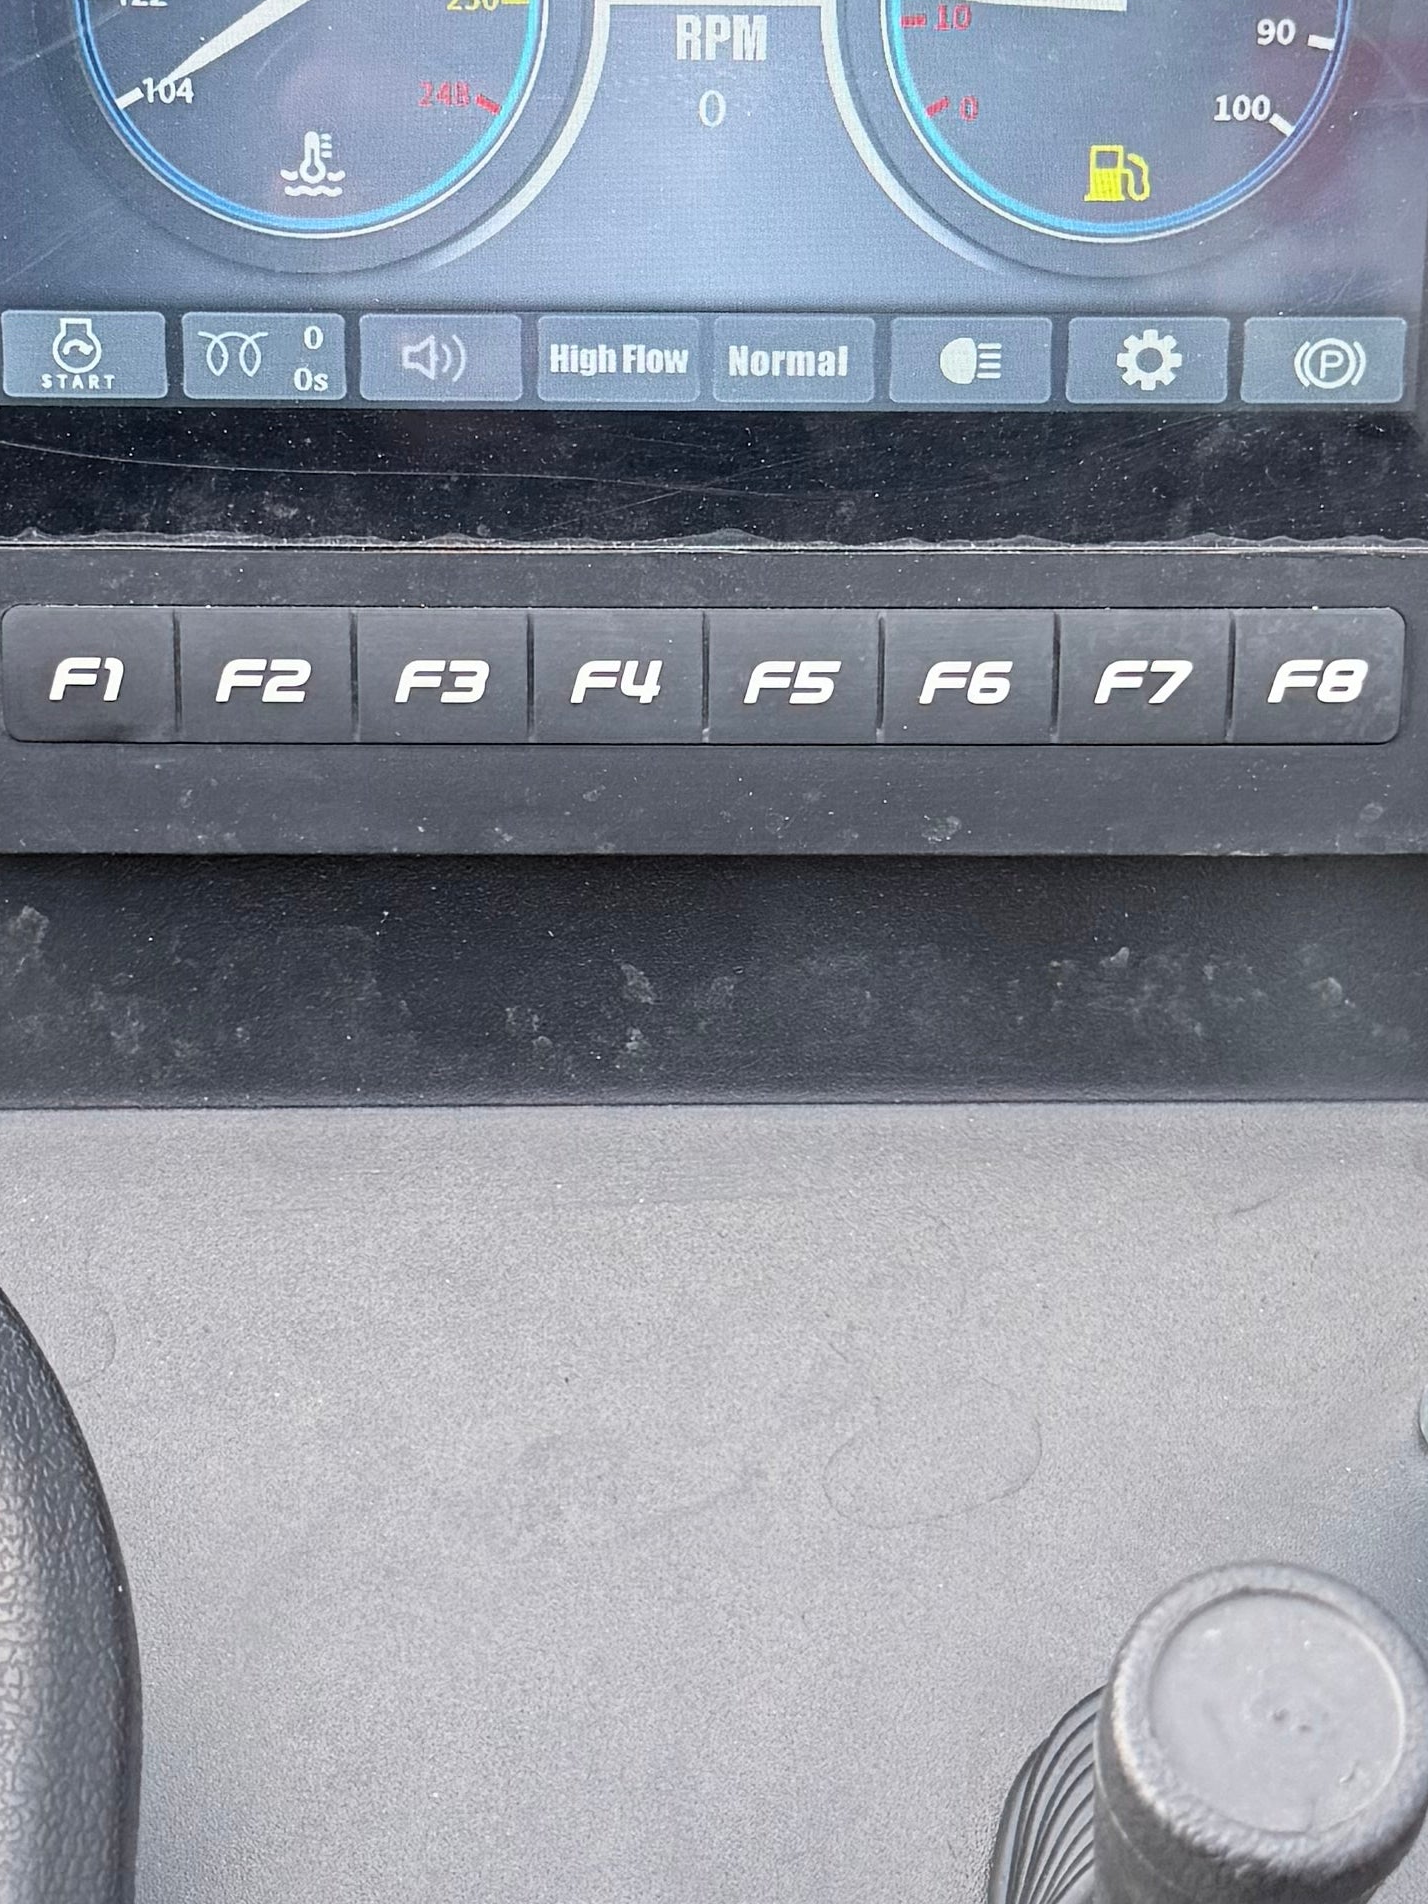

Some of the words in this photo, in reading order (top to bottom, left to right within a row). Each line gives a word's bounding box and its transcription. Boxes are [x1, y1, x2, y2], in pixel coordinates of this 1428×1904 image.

[934, 4, 972, 32] 10
[1256, 18, 1295, 46] 90
[676, 14, 767, 61] RPM
[142, 77, 194, 105] 104
[699, 89, 726, 127] 0
[959, 96, 979, 122] 0
[1213, 94, 1271, 123] 100
[303, 325, 324, 350] 0
[550, 343, 616, 377] High
[622, 344, 689, 375] Flow
[728, 345, 849, 378] Normal
[41, 373, 115, 390] START
[48, 656, 126, 703] F1
[215, 657, 315, 704] F2
[394, 658, 491, 704] F3
[570, 659, 664, 704] F4
[742, 660, 843, 705] F5
[917, 660, 1015, 705] F6
[1093, 659, 1194, 705] F7
[1266, 658, 1369, 704] F8
